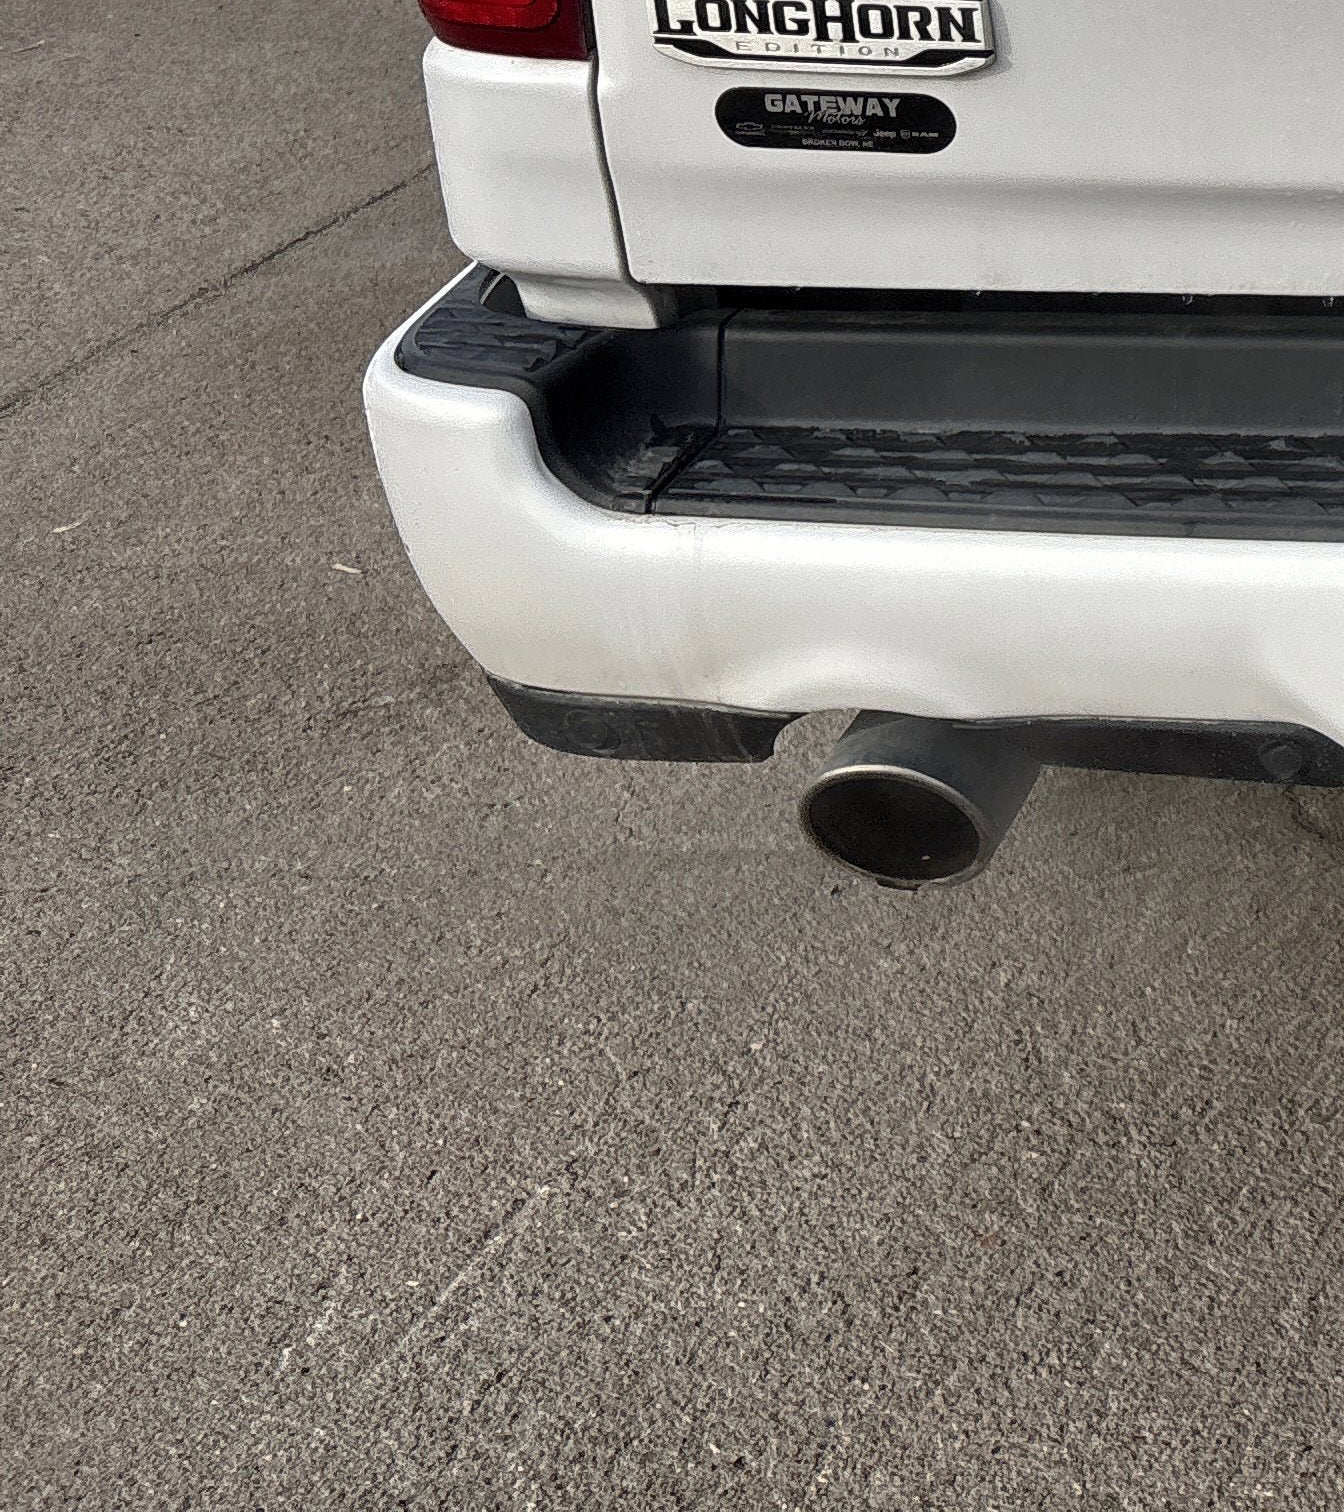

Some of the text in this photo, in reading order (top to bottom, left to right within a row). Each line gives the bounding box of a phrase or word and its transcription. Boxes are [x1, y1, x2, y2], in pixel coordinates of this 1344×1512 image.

[735, 41, 900, 57] EDITION
[764, 93, 901, 118] GATEWAY
[804, 109, 867, 125] Motors
